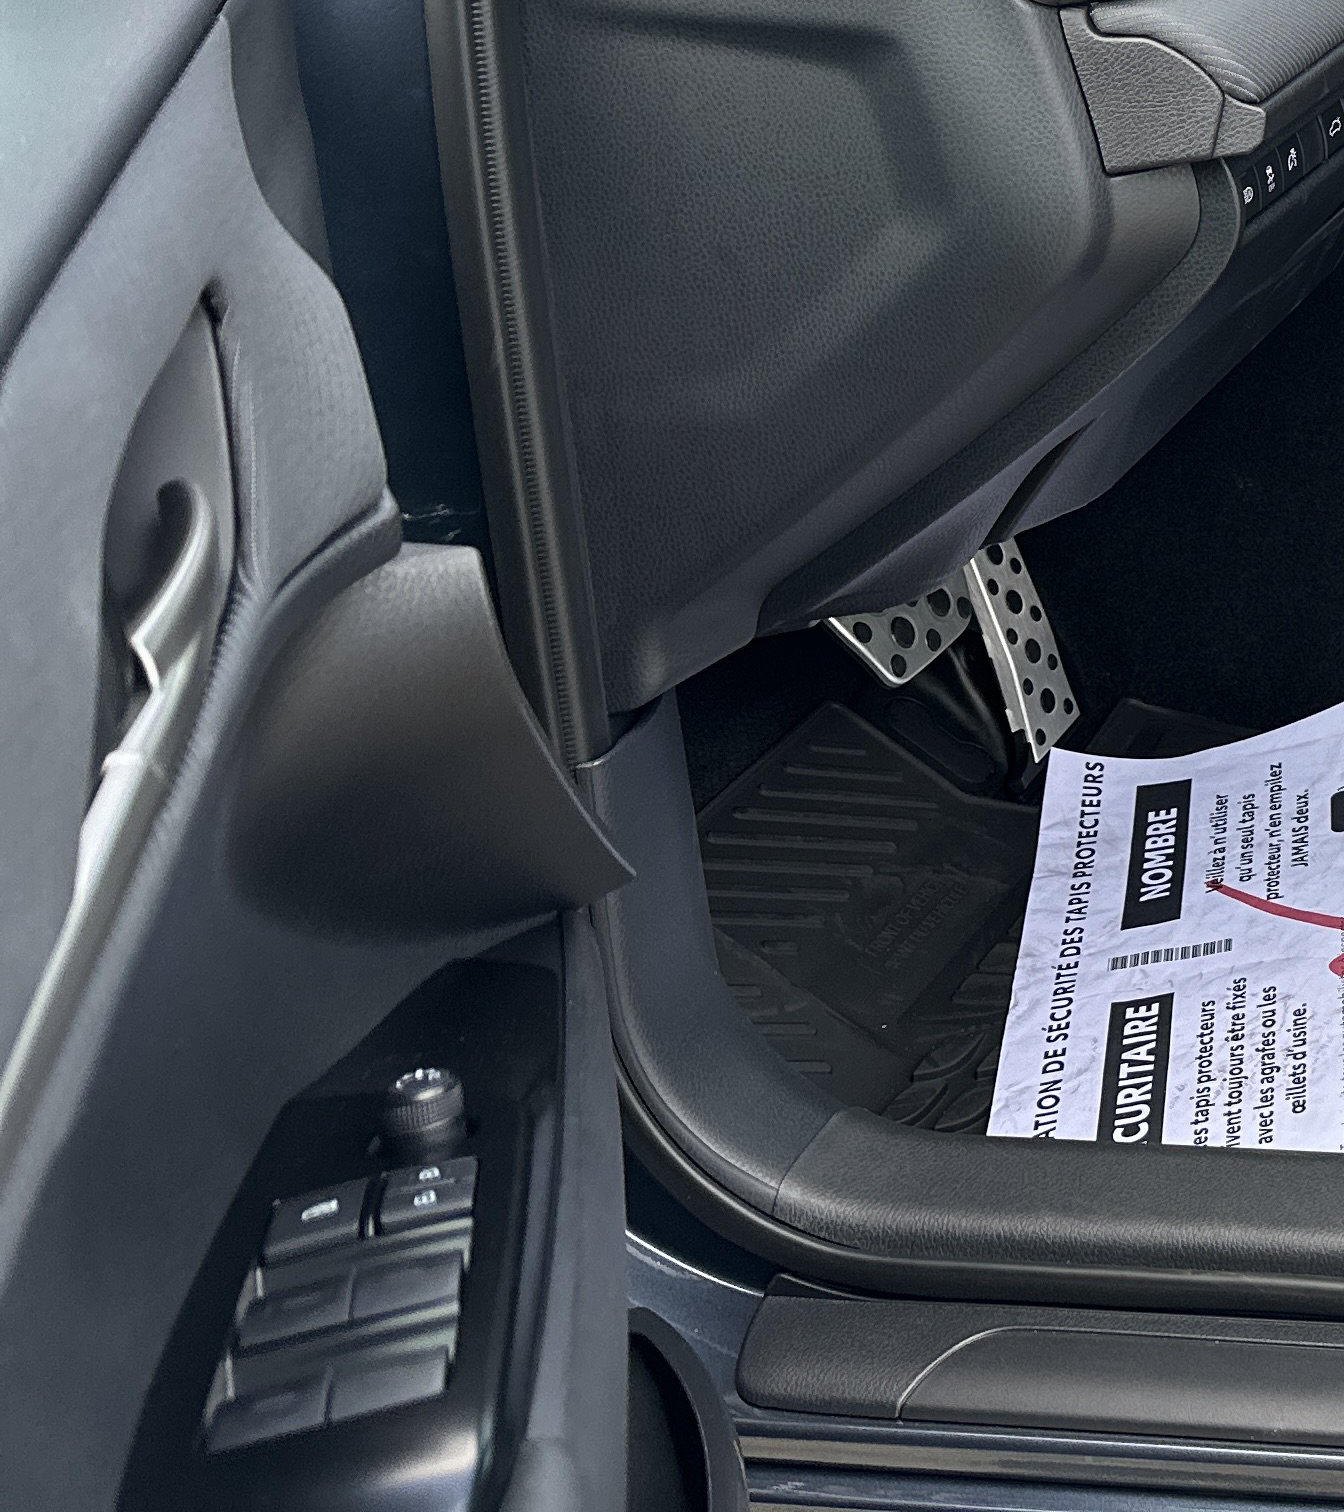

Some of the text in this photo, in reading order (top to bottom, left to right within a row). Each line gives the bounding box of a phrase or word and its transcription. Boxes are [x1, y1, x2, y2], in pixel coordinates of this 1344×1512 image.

[1071, 761, 1105, 879] PROTECTEURS
[1139, 807, 1178, 902] NOMBRE
[1204, 794, 1229, 894] Veillez à n'utiliser
[1235, 793, 1259, 882] qu'un seul tapis
[1262, 762, 1287, 901] protecteur, n'en empilez
[1290, 789, 1309, 867] JAMAIS deux.
[1059, 926, 1085, 959] DES
[1064, 881, 1092, 924] TAPIS
[1041, 960, 1080, 1043] SÉCURITÉ
[1224, 1012, 1246, 1043] être
[1226, 977, 1247, 1011] fixés
[1041, 1047, 1067, 1075] DE
[1112, 1002, 1160, 1145] CURITAIRE
[1189, 1000, 1216, 1148] es tapis protecteurs
[1223, 1044, 1249, 1107] toujours
[1253, 986, 1281, 1145] avec les agrafes ou les
[1285, 1003, 1307, 1114] œillets d'usine.
